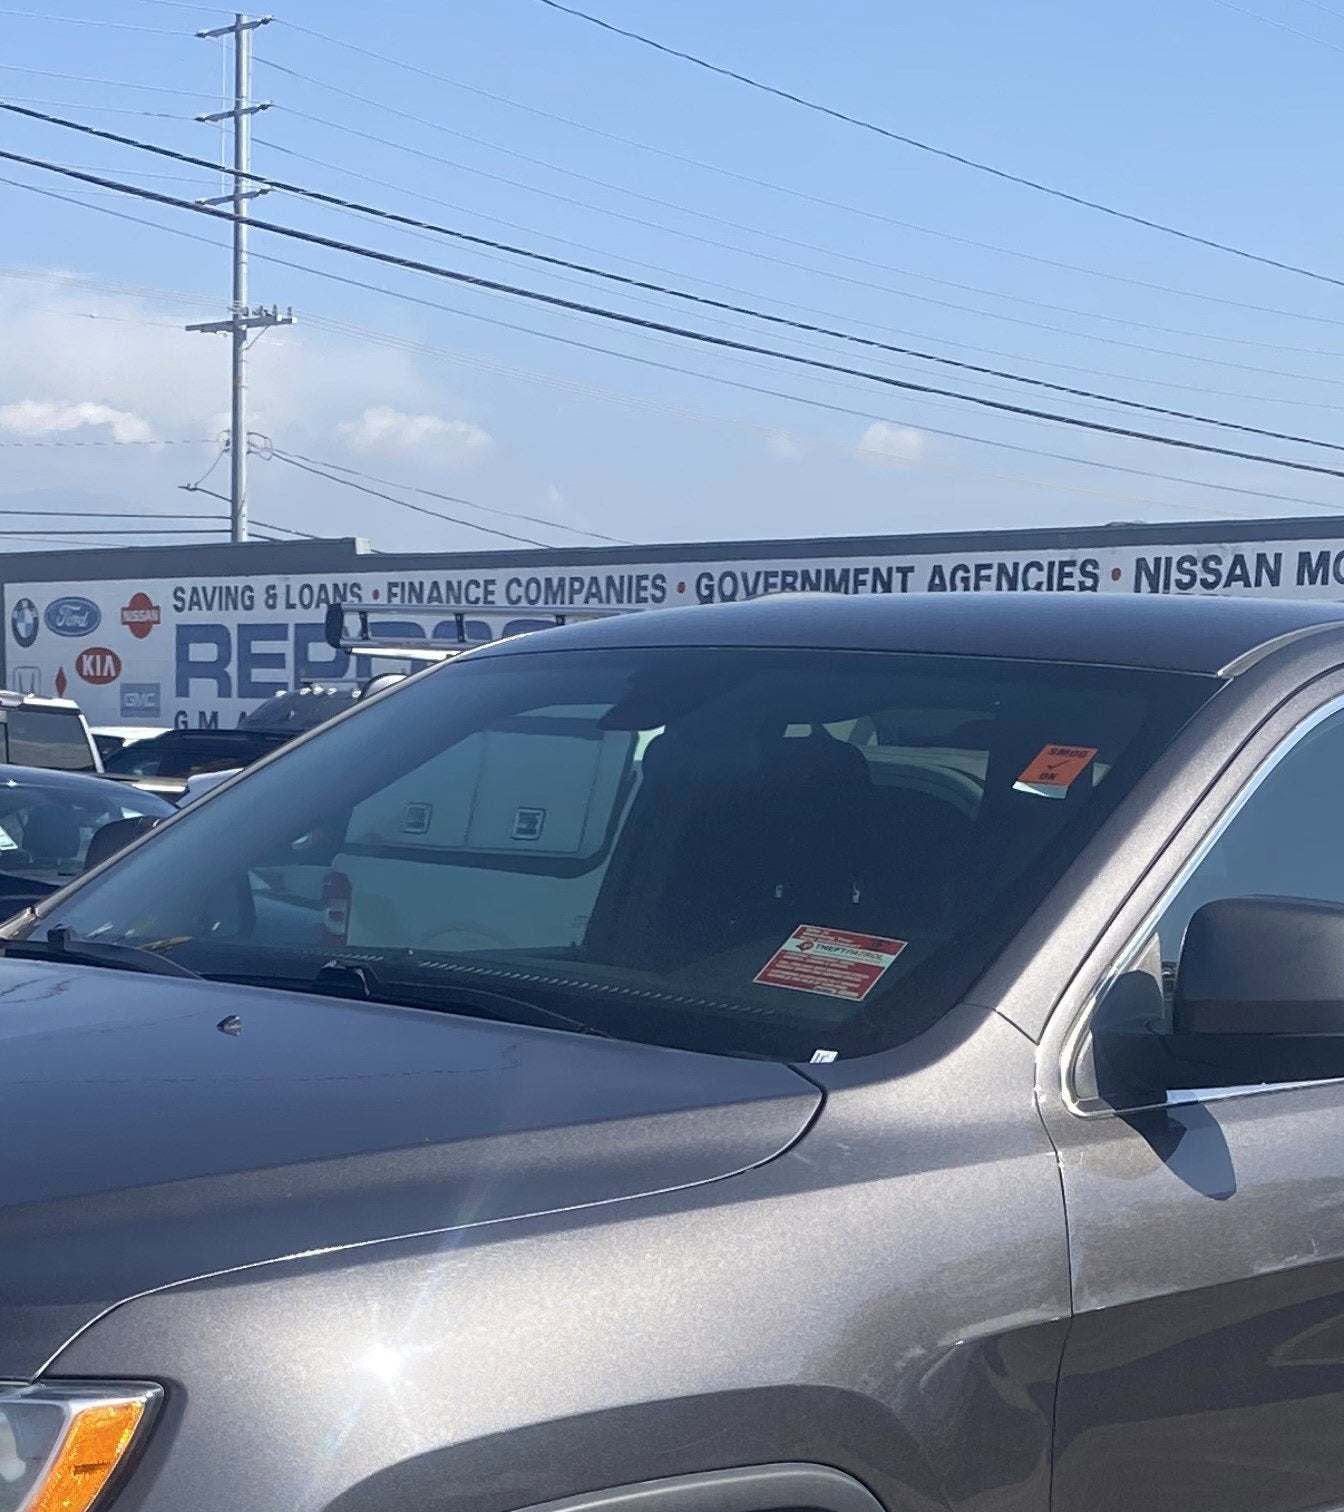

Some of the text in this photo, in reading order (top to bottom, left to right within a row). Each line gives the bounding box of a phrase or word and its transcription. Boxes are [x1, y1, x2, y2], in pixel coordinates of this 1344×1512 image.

[387, 572, 667, 606] FINANCE COMPANIES
[696, 559, 1100, 605] GOVERNMENT AGENCIES
[1134, 552, 1281, 594] NISSAN
[173, 581, 362, 613] SAVING & LOANS
[57, 604, 88, 628] Ford
[123, 609, 160, 623] NISSAN
[82, 654, 116, 677] KIA
